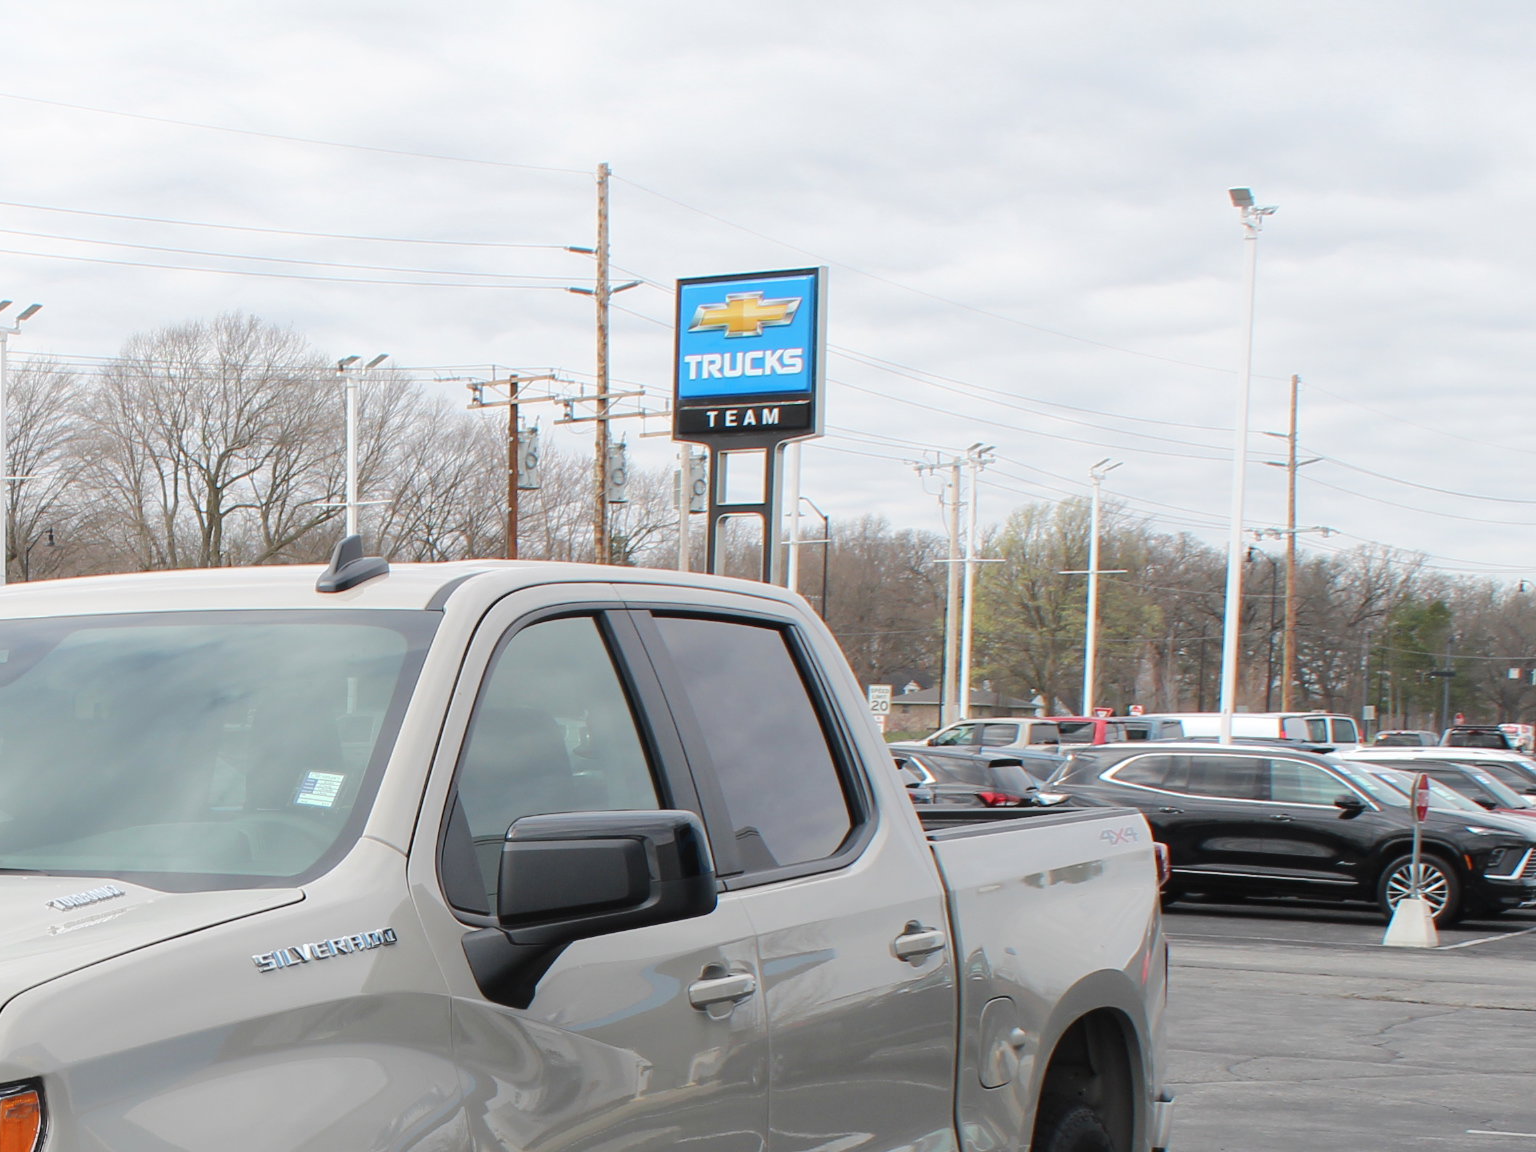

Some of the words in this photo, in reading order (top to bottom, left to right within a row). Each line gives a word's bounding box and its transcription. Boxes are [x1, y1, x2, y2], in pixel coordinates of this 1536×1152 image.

[684, 348, 804, 380] TRUCKS
[706, 408, 780, 427] TEAM
[871, 700, 889, 711] 20
[252, 926, 398, 973] SILVERADO
